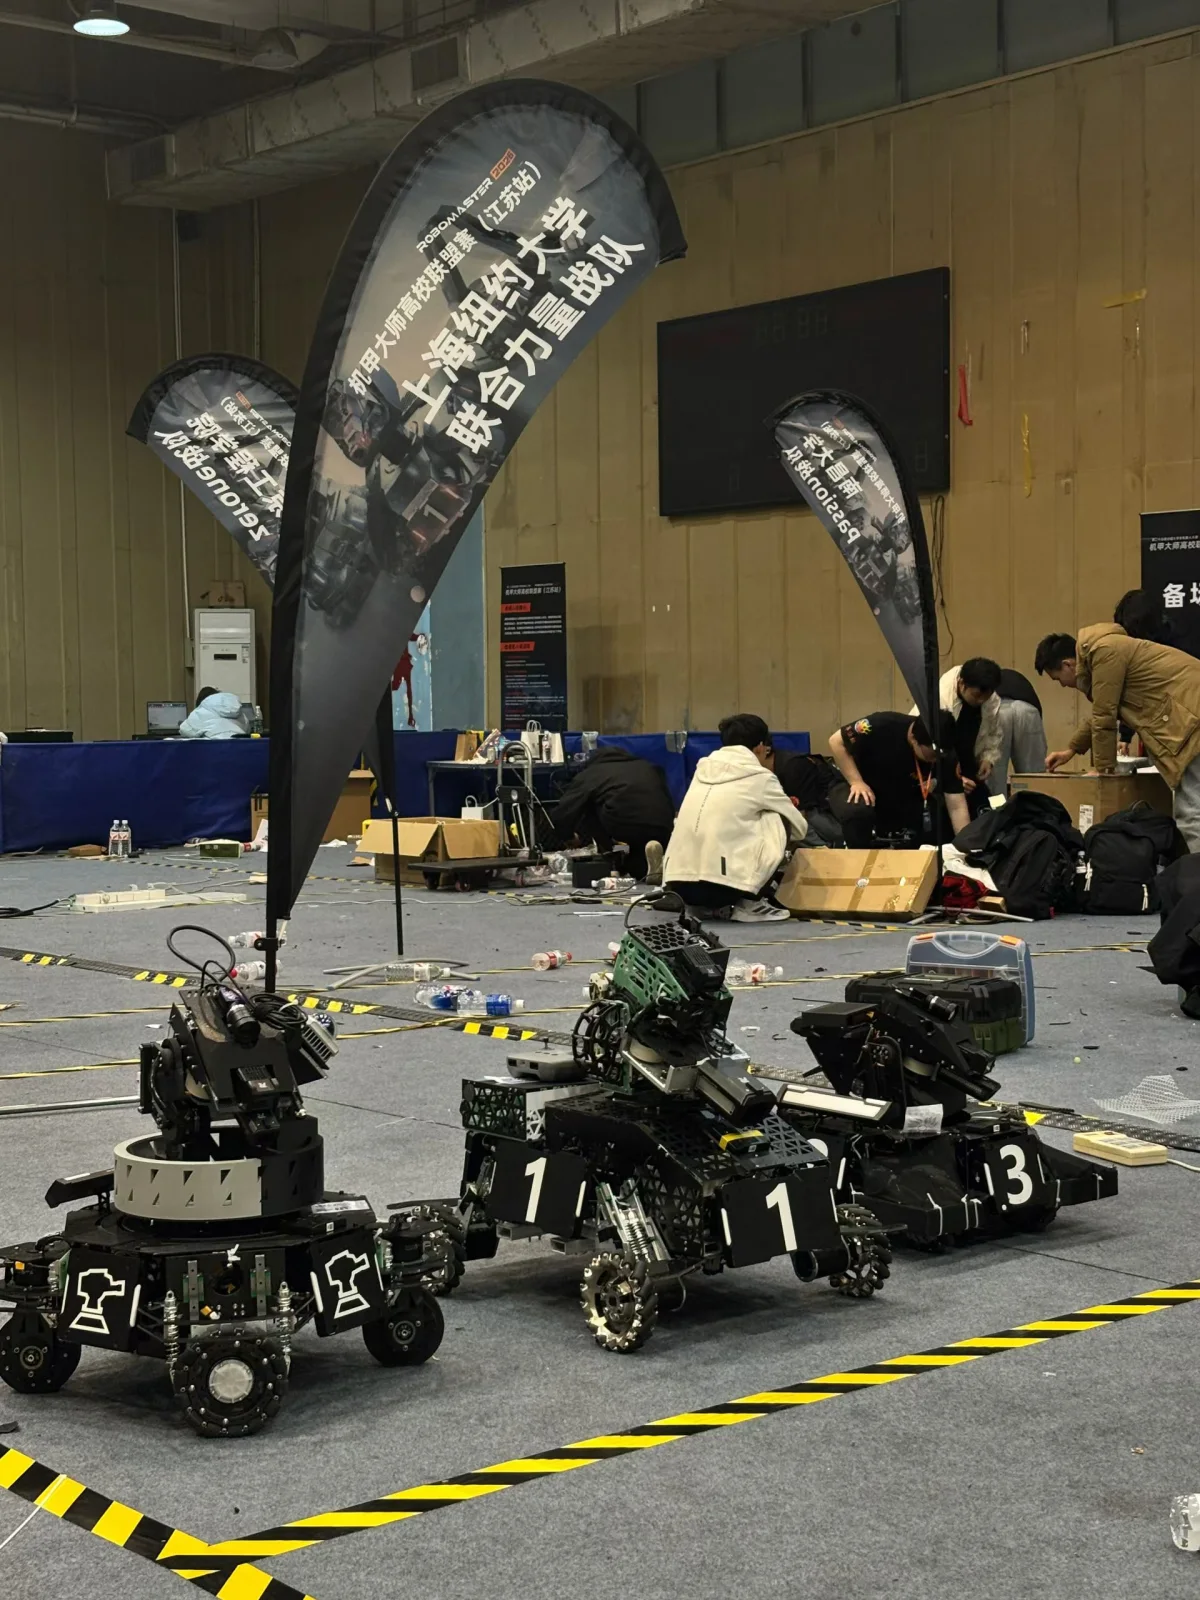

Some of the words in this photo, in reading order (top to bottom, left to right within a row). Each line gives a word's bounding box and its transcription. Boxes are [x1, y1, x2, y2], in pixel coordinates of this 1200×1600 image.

[416, 177, 494, 253] ROBOMASTER
[491, 149, 516, 180] 2026
[347, 161, 541, 396] 机甲大师高校联盟赛（江苏站）
[401, 197, 594, 424] 上海纽约大学
[445, 235, 645, 454] 联合力量战队
[524, 1157, 547, 1223] 1
[765, 1182, 798, 1251] 1
[1000, 1144, 1033, 1205] 3
